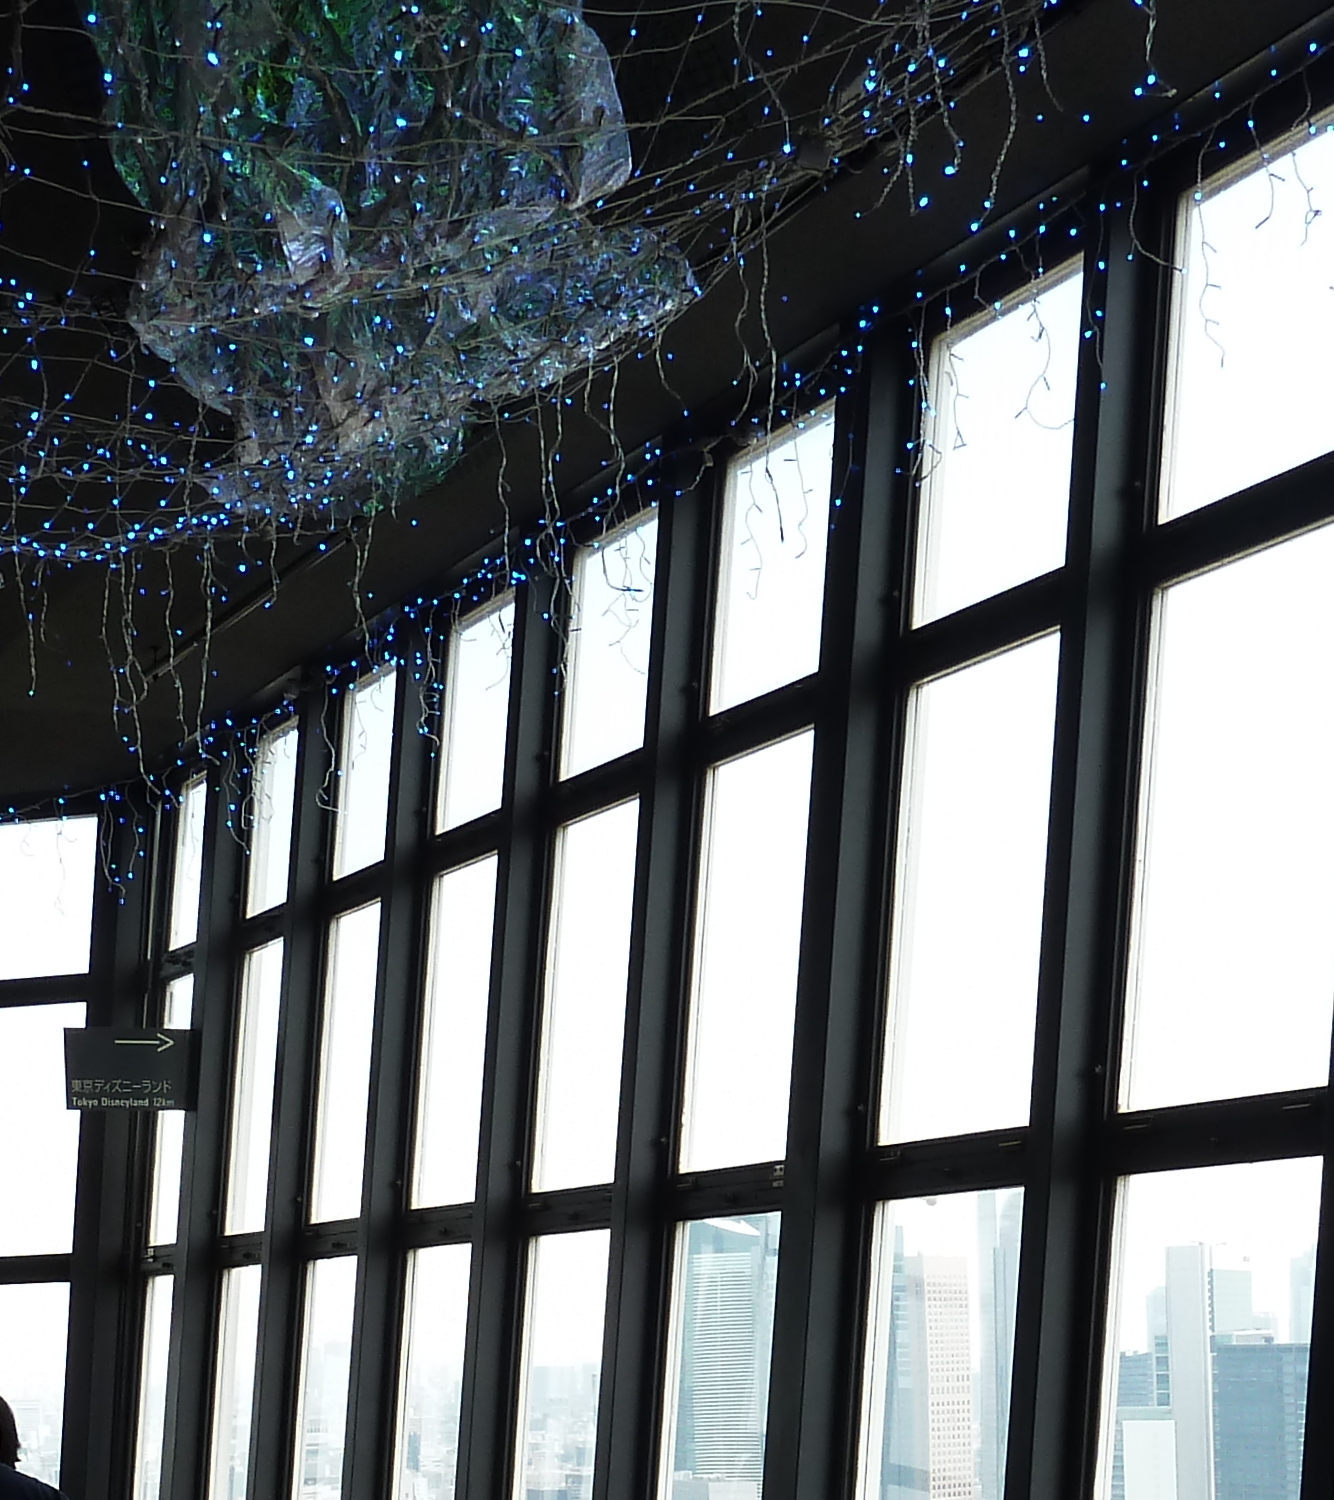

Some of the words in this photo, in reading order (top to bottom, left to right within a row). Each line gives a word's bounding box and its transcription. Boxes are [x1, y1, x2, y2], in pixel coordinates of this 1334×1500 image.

[71, 1078, 172, 1094] 東京ディズニーランド
[72, 1096, 98, 1109] Tokyo
[101, 1097, 149, 1109] Disneyland
